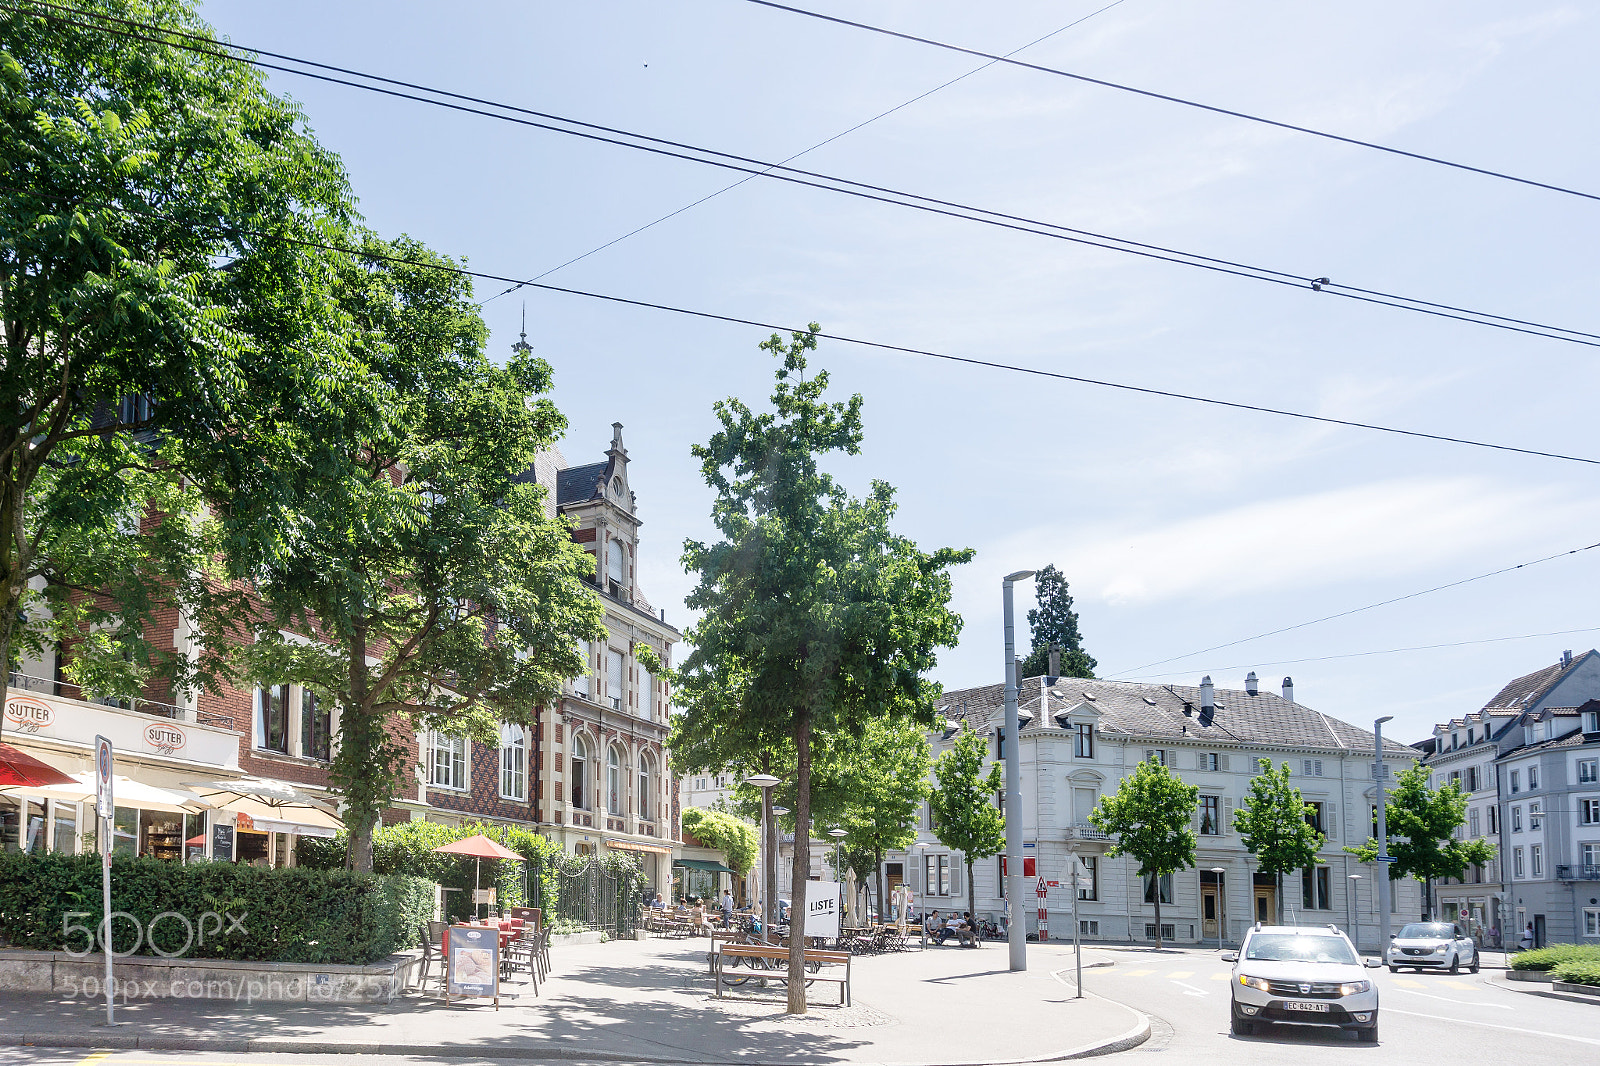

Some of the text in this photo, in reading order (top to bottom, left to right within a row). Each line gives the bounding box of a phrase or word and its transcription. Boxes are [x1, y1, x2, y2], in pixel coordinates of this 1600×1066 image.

[8, 703, 49, 721] SUTTER
[149, 729, 182, 744] SUTTER
[810, 898, 834, 911] LISTE
